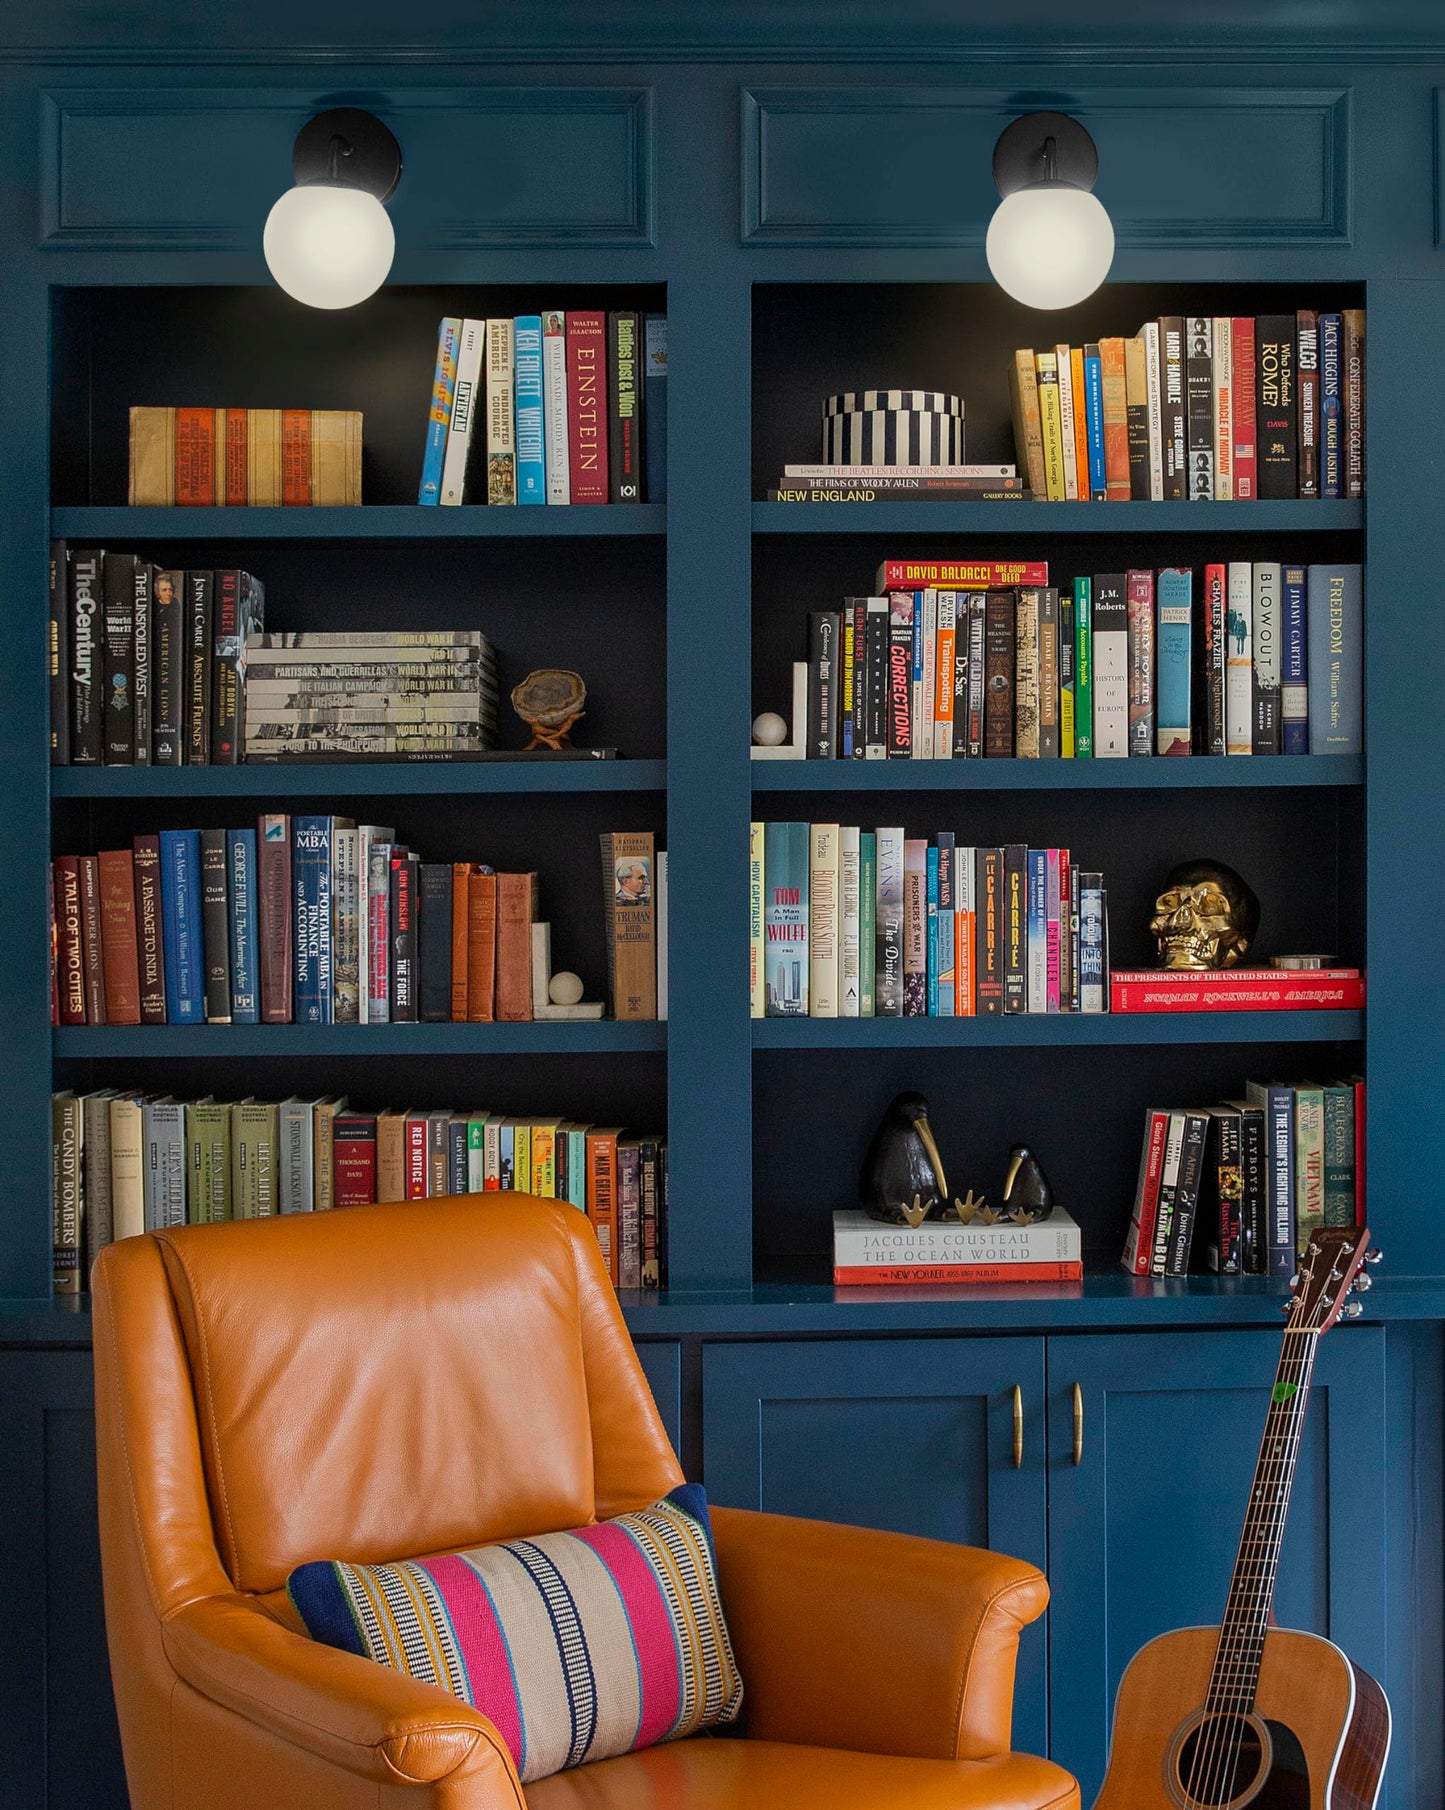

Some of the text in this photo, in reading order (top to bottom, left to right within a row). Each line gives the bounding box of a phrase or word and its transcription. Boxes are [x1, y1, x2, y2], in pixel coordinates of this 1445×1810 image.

[491, 324, 500, 371] AMBROSE
[516, 330, 540, 398] KEN FOLLETT
[618, 320, 634, 357] Battles
[1300, 329, 1316, 369] WILCO
[1325, 320, 1338, 395] JACK HIGGINS
[436, 328, 454, 420] ELVIS IGNITED
[619, 360, 634, 380] lost
[619, 382, 633, 390] &
[1262, 343, 1277, 407] ROME?
[1281, 343, 1290, 406] Who Defends
[1304, 382, 1312, 410] SUNKEN
[454, 382, 471, 431] ANTIETAM
[578, 348, 598, 471] EINSTEIN
[619, 392, 635, 417] Won
[1219, 387, 1229, 476] MIRACLE AT MIDWAY
[1304, 412, 1313, 446] TREASURE
[518, 407, 542, 464] WHITEOUT
[1327, 418, 1337, 484] ROUGH JUSTICE
[778, 490, 875, 501] NEW ENGLAND
[907, 567, 990, 580] DAVID BALDACCI
[996, 565, 1026, 573] ONE GOOD
[1002, 574, 1020, 582] DEED
[135, 573, 148, 697] THE UNSPOILED WEST
[193, 578, 205, 648] JOHN LE CARRÉ
[1261, 574, 1271, 666] BLOWOUT
[1290, 589, 1299, 676] JIMMY CARTER
[1330, 577, 1344, 654] FREEDOM
[275, 667, 386, 677] PARTISANS AND GUERRILLAS
[398, 667, 424, 676] WORLD
[427, 667, 446, 675] WAR
[891, 645, 910, 747] CORRECTIONS
[940, 638, 952, 712] Trainspotting
[956, 656, 966, 696] Dr. Sax
[1331, 661, 1340, 728] William Safire
[193, 655, 203, 746] ABSOLUTE FRIENDS
[818, 834, 829, 858] Trudeau
[881, 839, 893, 897] EVANS
[399, 870, 408, 930] DON WINSLOW
[774, 888, 800, 905] TOM
[939, 849, 949, 905] We Happy WASPs
[64, 871, 81, 1013] A TALE OF TWO CITIES
[143, 876, 157, 985] A PASSAGE TO INDIA
[298, 898, 307, 981] ACCOUNTING
[309, 905, 318, 957] FINANCE
[320, 892, 328, 951] PORTABLE
[616, 912, 650, 921] TRUMAN
[767, 925, 806, 941] WOLFE
[812, 870, 835, 959] BLOODY ROADS SOUTH
[320, 954, 328, 979] MBA
[885, 919, 899, 986] The Divide
[1115, 974, 1132, 982] THE
[1190, 973, 1202, 981] OF
[320, 981, 327, 989] IN
[397, 959, 406, 1006] THE FORCE
[1230, 1130, 1238, 1151] JEFF
[1300, 1097, 1308, 1132] KARNOW
[1309, 1096, 1318, 1130] STANLEY
[63, 1107, 74, 1244] THE CANDY BOMBERS
[290, 1121, 301, 1209] STONEWALL JACKSON AT
[413, 1127, 422, 1182] RED NOTICE
[456, 1136, 465, 1164] david
[502, 1172, 510, 1188] Tim
[595, 1156, 611, 1212] MARK GREANEY
[1276, 1113, 1289, 1244] THE LEGION'S FIGHTING BULLDOG
[1307, 1150, 1320, 1213] VIETNAM
[863, 1233, 1030, 1249] JACQUES COUSTEAU
[864, 1249, 1030, 1262] THE OCEAN WORLD
[1153, 1201, 1169, 1272] MAXIMUM BOB
[1174, 1212, 1189, 1272] JOHN GRISHAM
[890, 1269, 945, 1279] NEW YORKER
